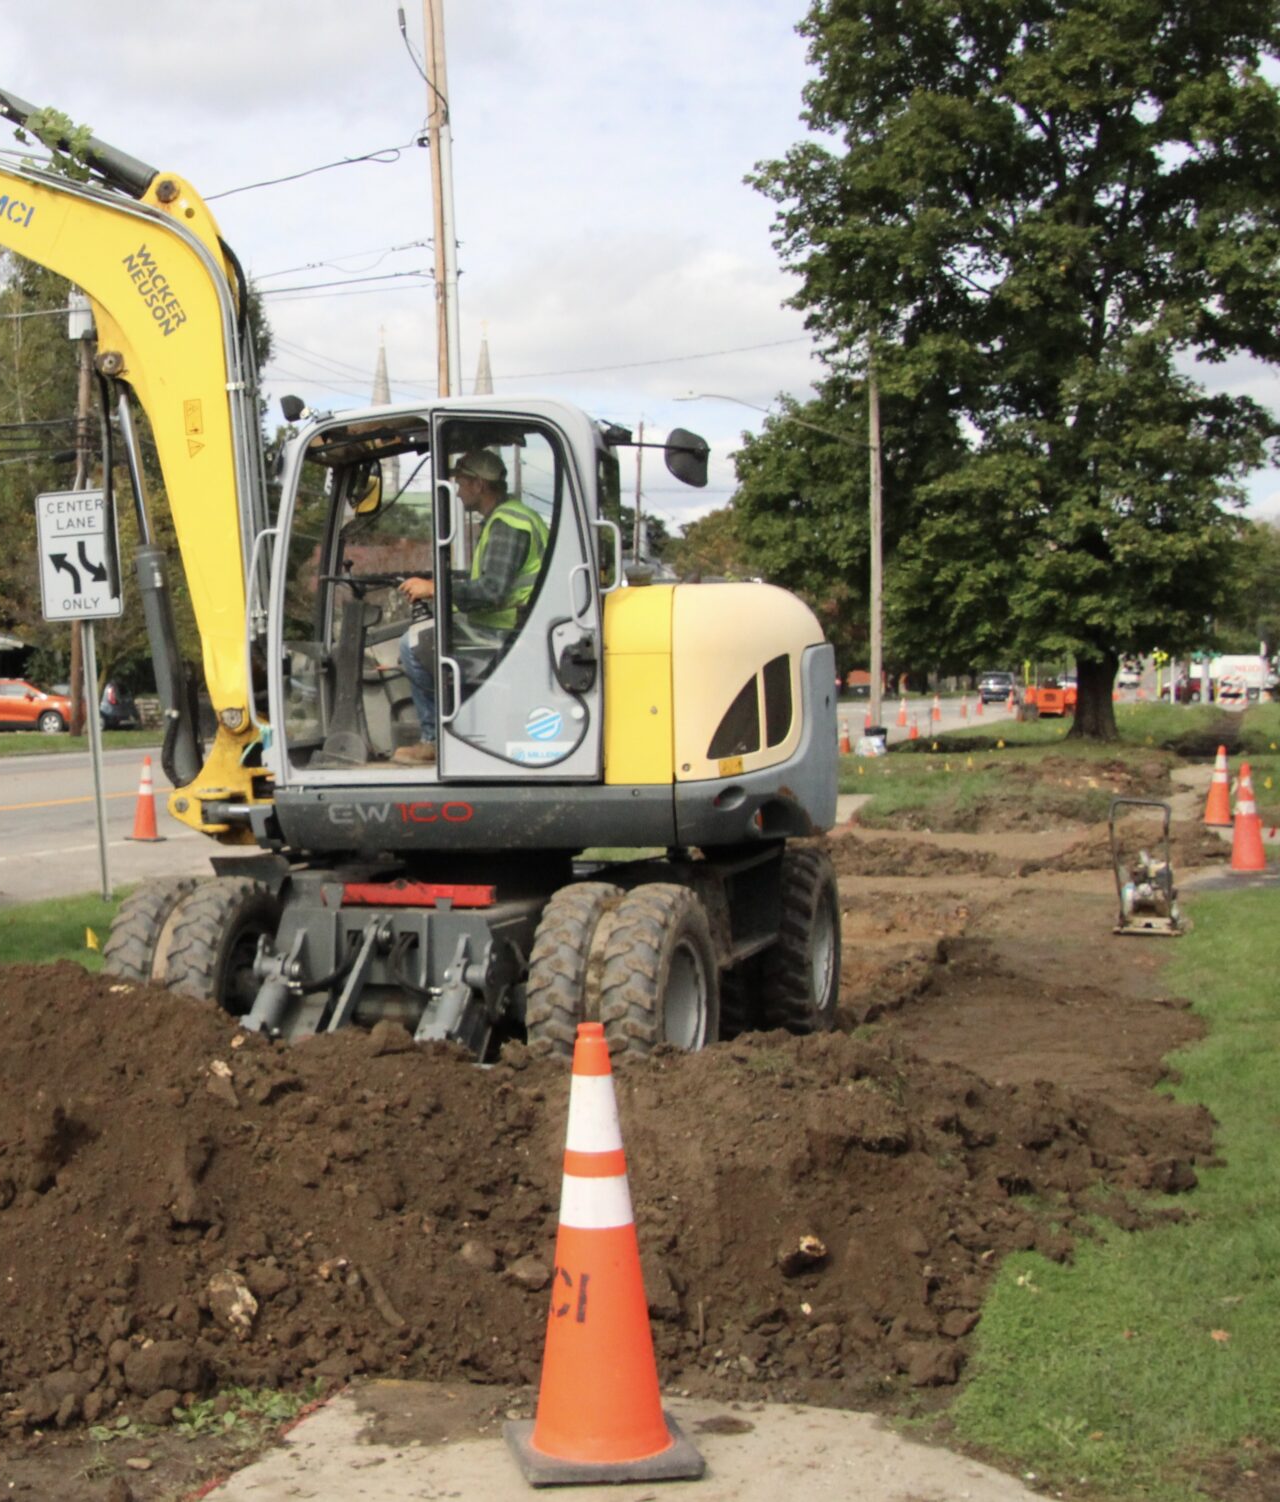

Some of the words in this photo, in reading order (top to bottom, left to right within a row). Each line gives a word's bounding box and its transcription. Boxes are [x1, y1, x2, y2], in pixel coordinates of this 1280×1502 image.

[136, 244, 187, 328] WACKER
[122, 253, 175, 336] NEUSON
[47, 500, 104, 514] CENTER
[56, 516, 96, 530] LANE
[62, 598, 100, 611] ONLY
